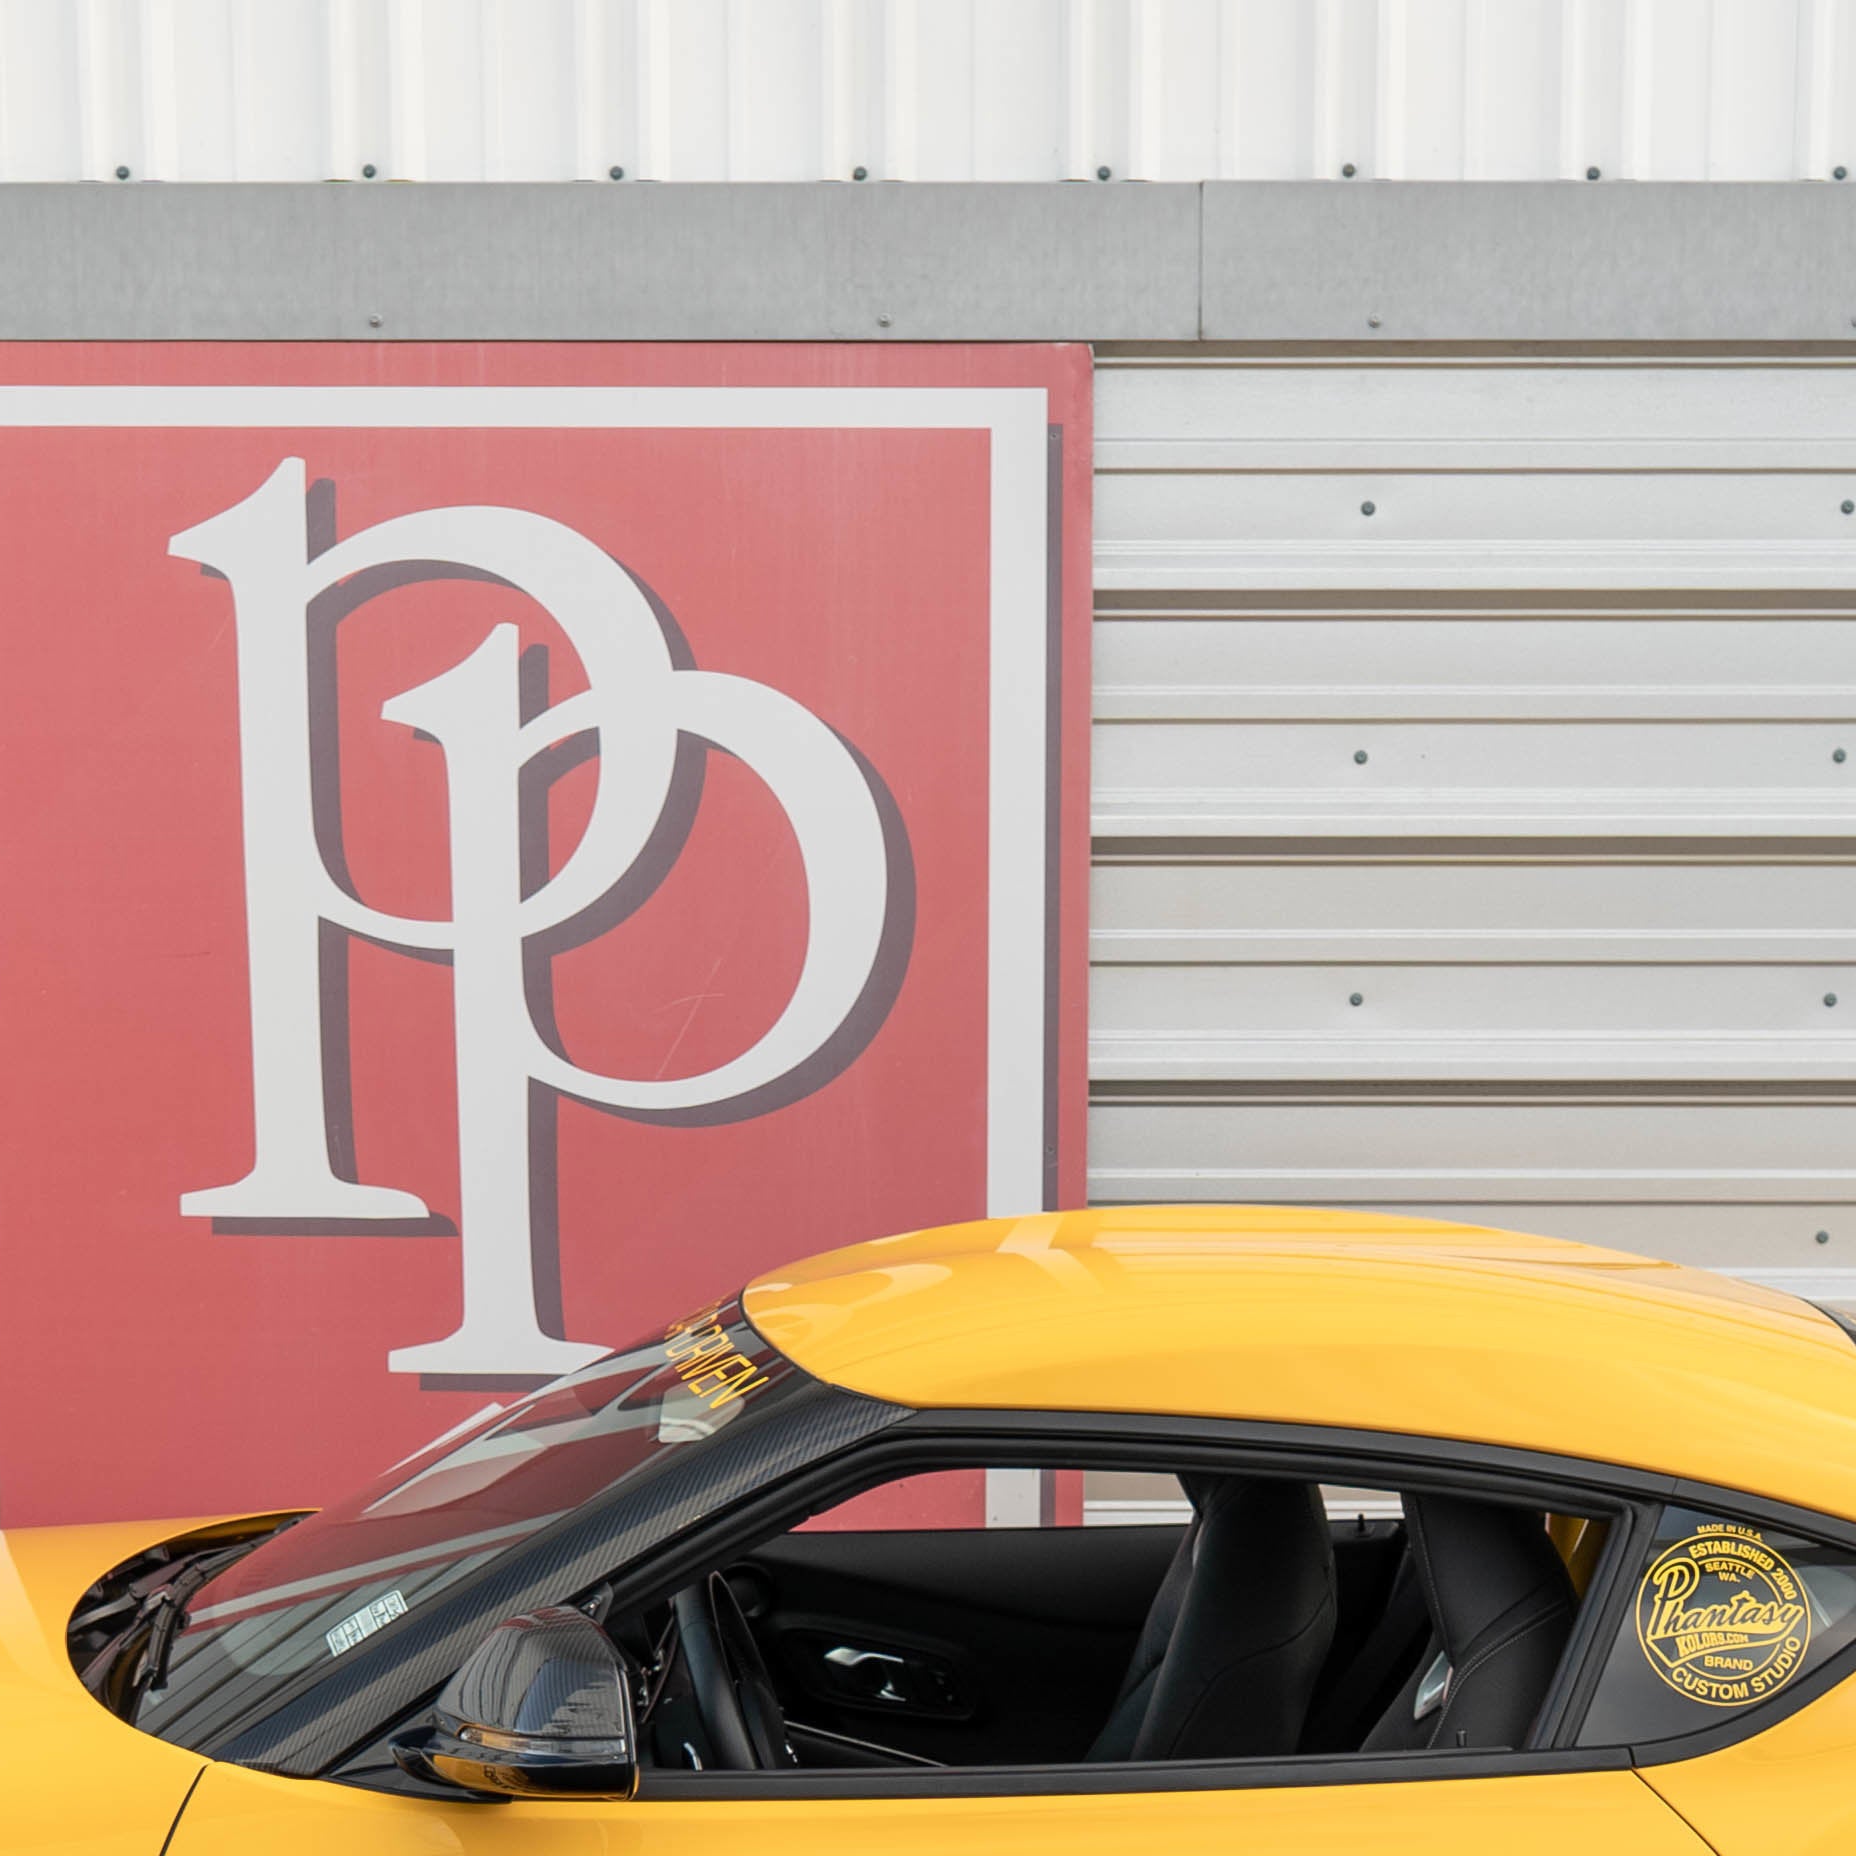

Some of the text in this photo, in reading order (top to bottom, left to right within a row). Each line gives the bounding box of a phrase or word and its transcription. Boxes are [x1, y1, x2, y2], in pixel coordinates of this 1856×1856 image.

[1697, 1523, 1724, 1534] MADE
[1688, 1540, 1797, 1600] ESTABLISHED 2000
[1705, 1561, 1755, 1580] SEATTLE
[1647, 1557, 1804, 1641] Phantasy
[1671, 1636, 1801, 1700] CUSTOM STUDIO
[1704, 1655, 1753, 1671] BRAND
